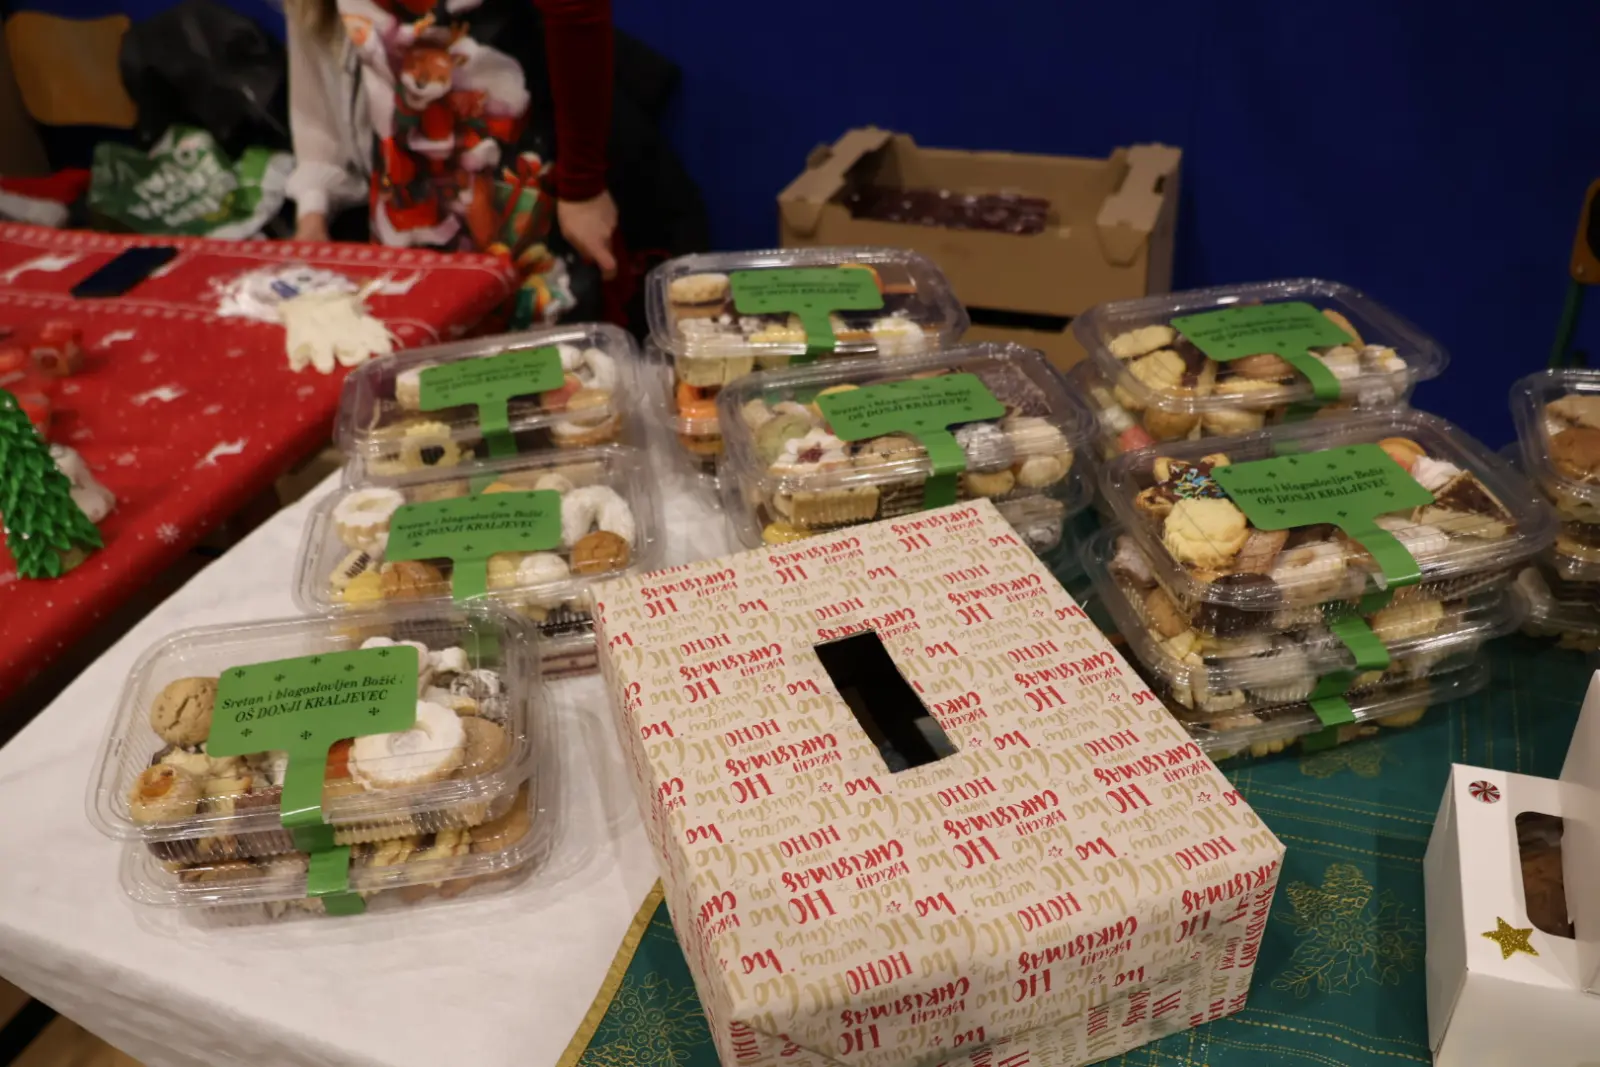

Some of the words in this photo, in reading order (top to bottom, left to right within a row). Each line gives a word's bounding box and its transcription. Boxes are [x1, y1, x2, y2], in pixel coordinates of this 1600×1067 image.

[890, 508, 977, 536] CHRISTMAS
[768, 538, 858, 567] CHRISTMAS
[896, 533, 932, 552] HO
[639, 569, 734, 600] CHRISTMAS
[772, 564, 809, 584] HO
[947, 574, 1040, 606] CHRISTMAS
[642, 597, 679, 619] HO
[955, 603, 994, 625] HO
[678, 644, 780, 681] CHRISTMAS
[1014, 651, 1114, 689] CHRISTMAS
[222, 696, 263, 710] Sretan
[268, 690, 273, 702] i
[276, 679, 358, 701] blagoslovljen
[235, 706, 256, 723] OŠ
[257, 701, 302, 720] DONJI
[304, 688, 388, 711] KRALJEVEC
[681, 677, 722, 702] HO
[1024, 686, 1067, 712] HO
[724, 734, 835, 777] CHRISTMAS
[1093, 743, 1201, 787] CHRISTMAS
[729, 772, 774, 803] HO
[1105, 783, 1153, 815] HO
[943, 791, 1057, 839] CHRISTMAS
[781, 841, 902, 894] CHRISTMAS
[952, 835, 1001, 869] HO
[787, 888, 836, 925] HO
[1017, 892, 1082, 932] HOHO
[1018, 916, 1138, 973] CHRISTMAS
[845, 951, 913, 995] HOHO
